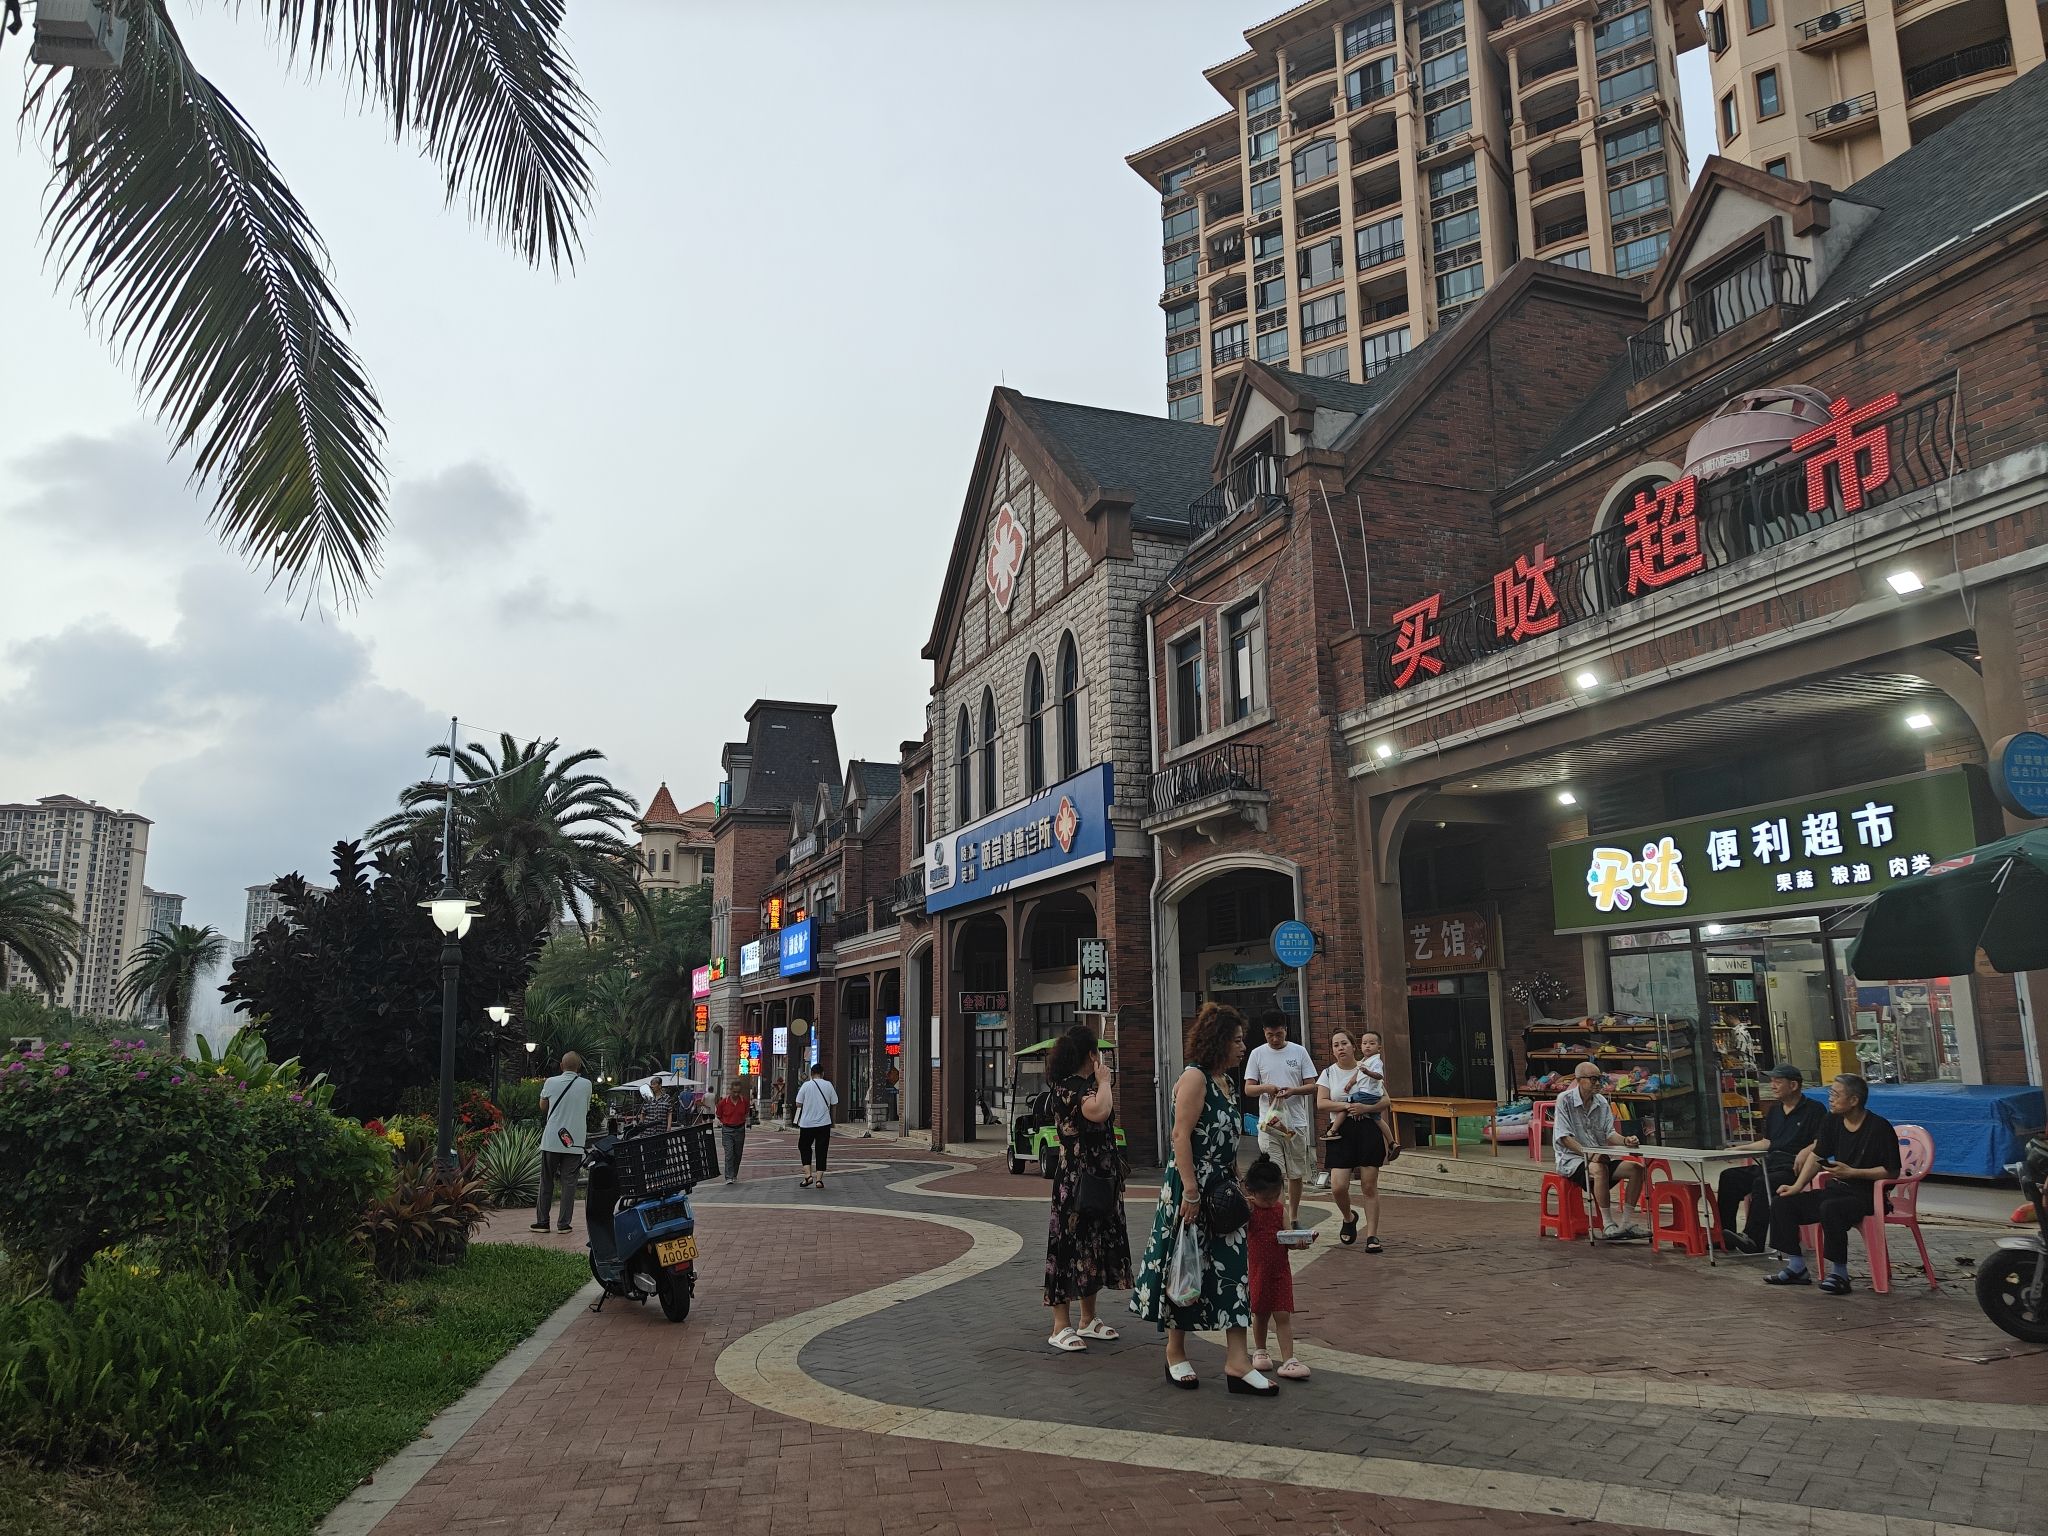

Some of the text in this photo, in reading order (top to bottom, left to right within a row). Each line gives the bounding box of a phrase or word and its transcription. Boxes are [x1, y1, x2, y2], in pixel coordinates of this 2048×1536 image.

[1391, 392, 1901, 688] 买哒超市
[1588, 801, 1895, 911] 买哒 便利超市
[1776, 854, 1931, 892] 果蔬 粮油 肉类
[1082, 941, 1106, 1010] 棋牌
[1725, 960, 1748, 969] WINE
[962, 994, 1008, 1010] 全科门诊
[662, 1247, 696, 1264] 40060
